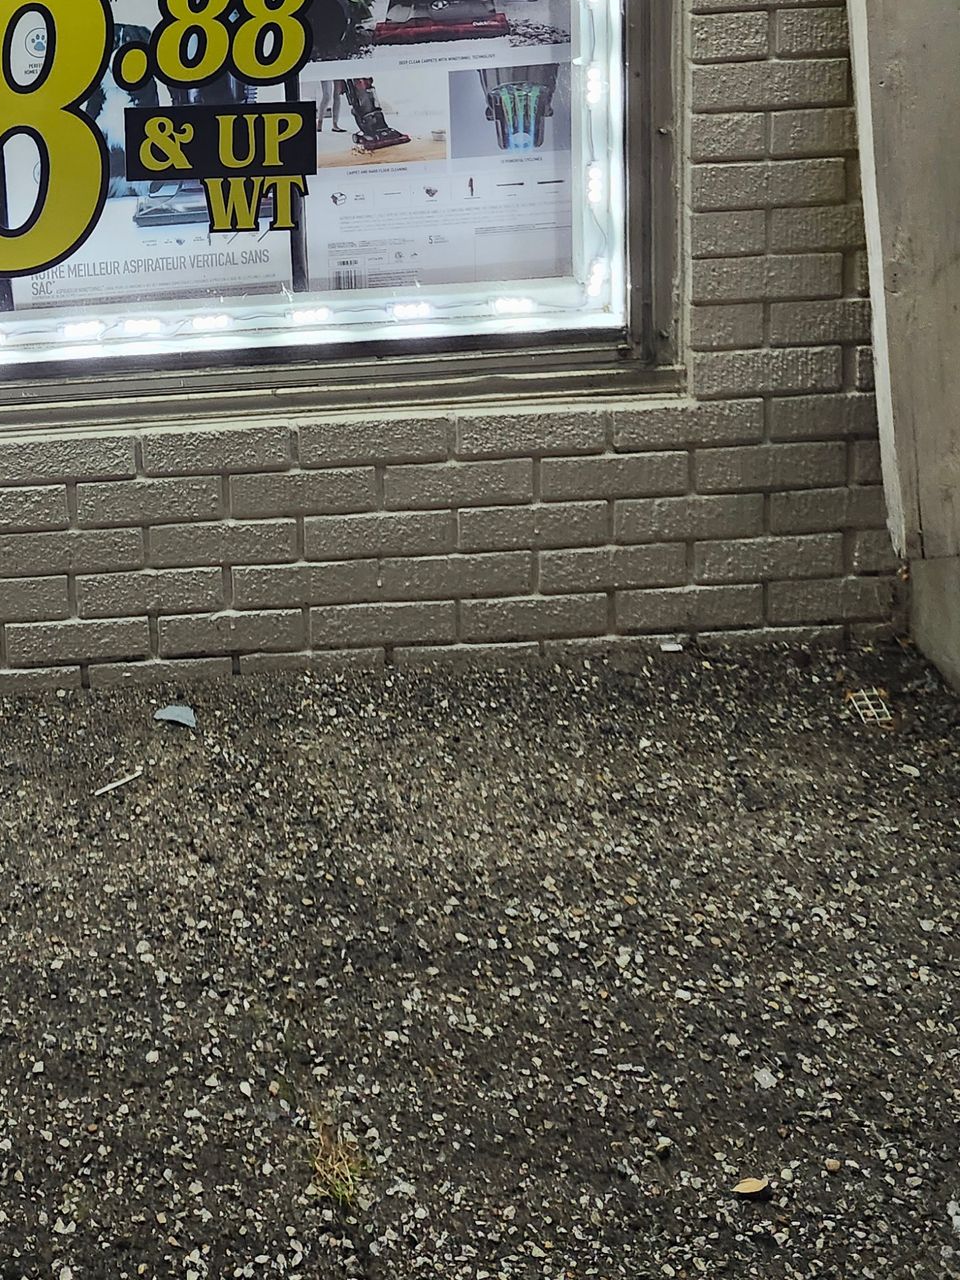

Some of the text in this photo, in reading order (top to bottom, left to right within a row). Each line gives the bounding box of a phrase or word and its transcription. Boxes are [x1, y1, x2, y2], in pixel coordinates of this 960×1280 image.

[140, 113, 304, 172] & UP
[200, 176, 309, 232] WT
[428, 235, 434, 245] 5
[67, 260, 120, 278] MEILLEUR
[123, 255, 186, 274] ASPIRATEUR
[189, 252, 238, 269] VERTICAL
[241, 249, 270, 265] SANS
